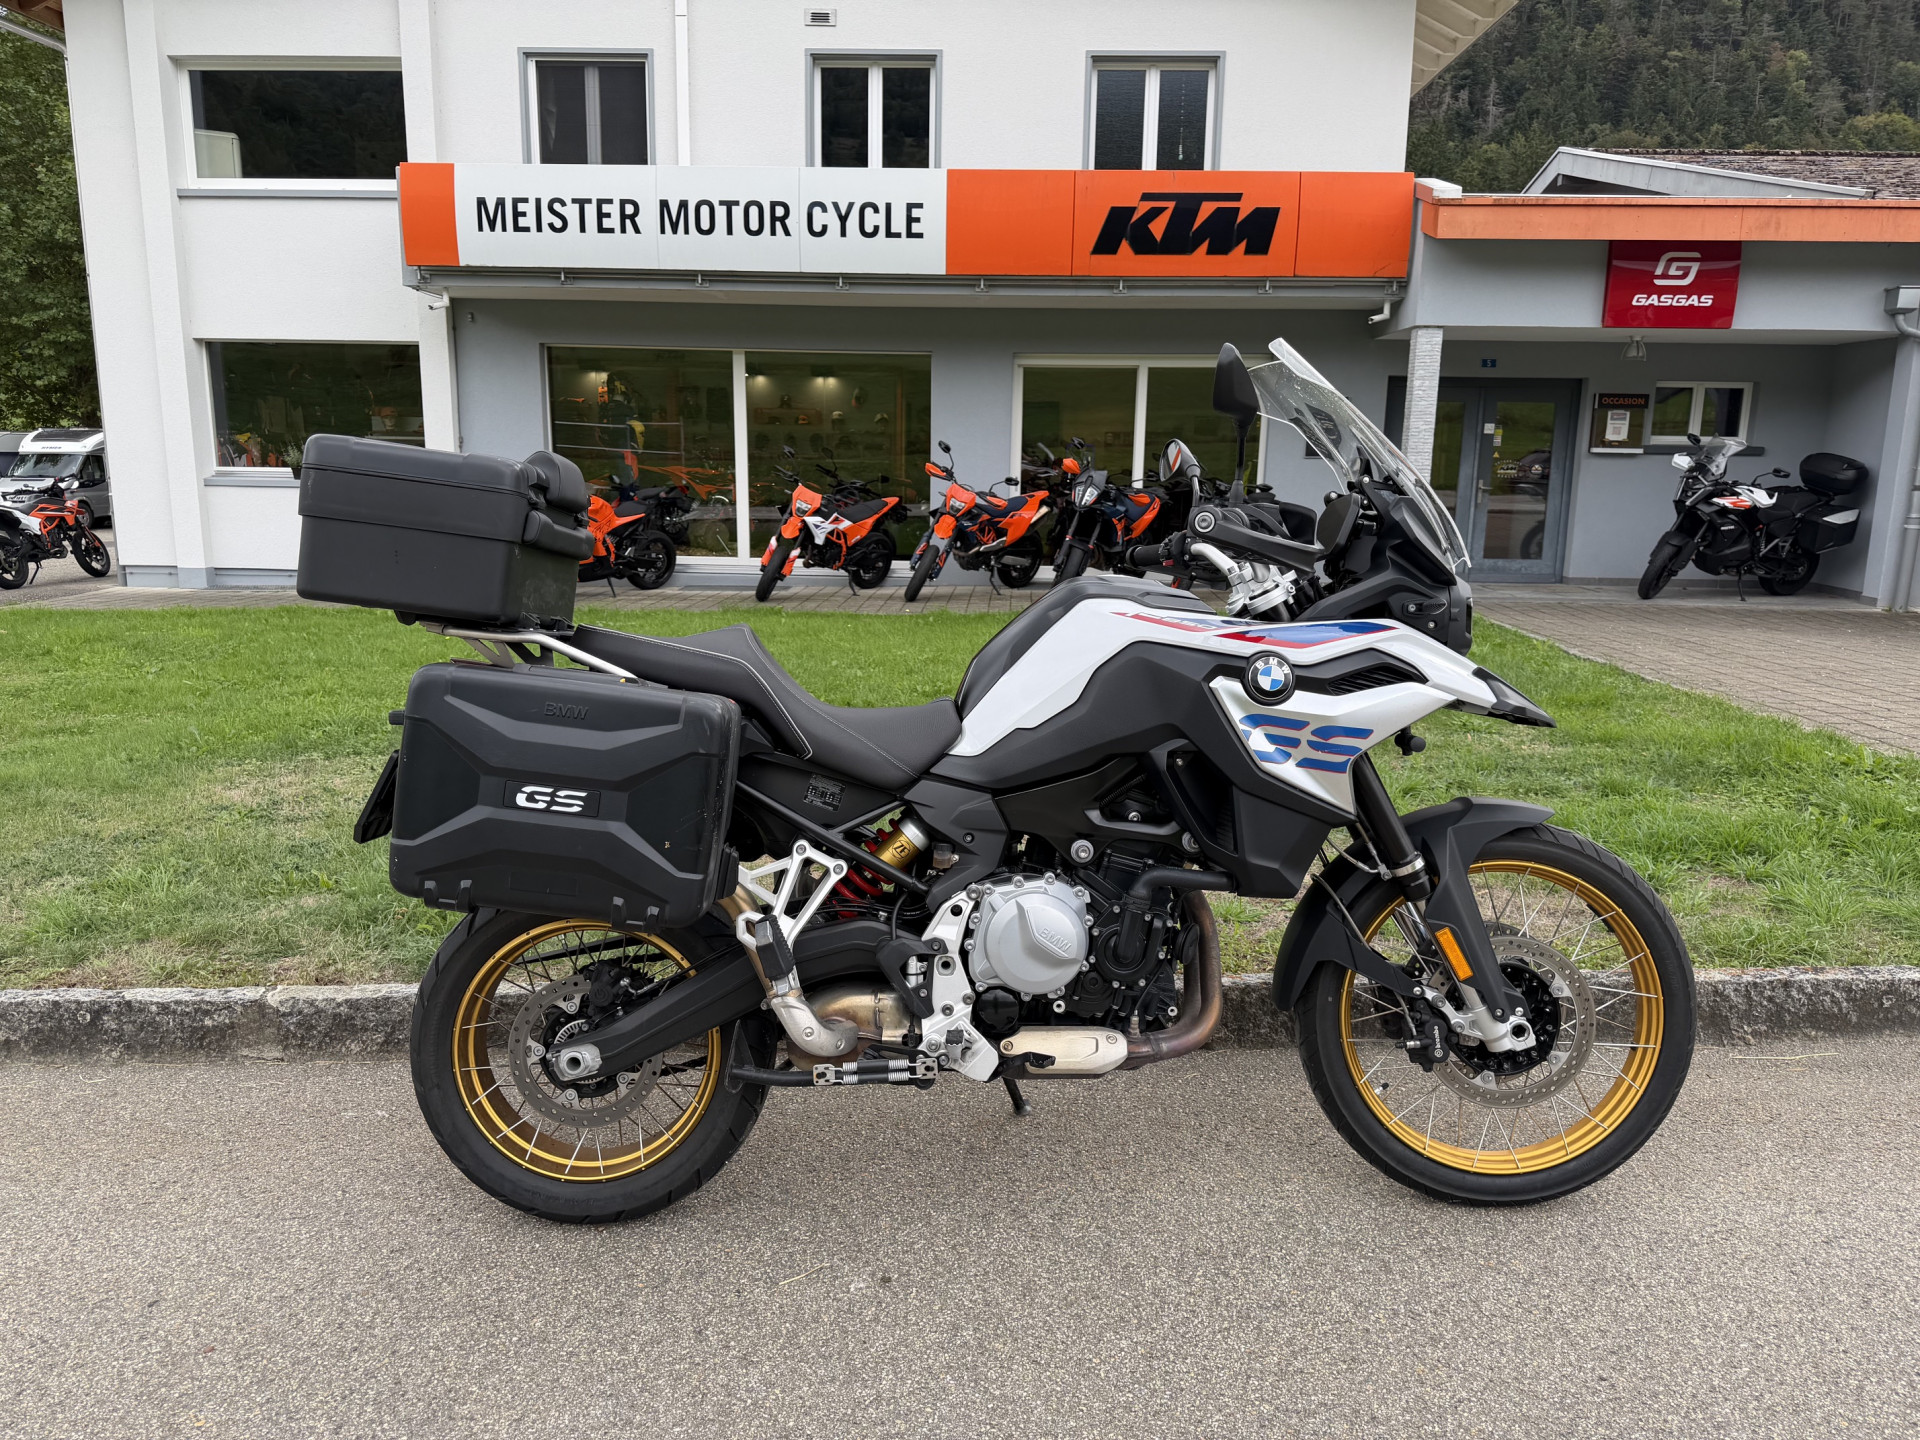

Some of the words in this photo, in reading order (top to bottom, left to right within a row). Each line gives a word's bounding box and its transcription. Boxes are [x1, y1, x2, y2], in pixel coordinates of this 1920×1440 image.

[475, 196, 642, 235] MEISTER
[658, 198, 793, 236] MOTOR
[805, 200, 925, 239] CYCLE
[1090, 192, 1281, 256] KTM
[1631, 294, 1714, 307] GASGAS
[1601, 397, 1646, 405] OCCASION
[1255, 656, 1291, 674] BMW
[543, 702, 589, 720] BMW
[515, 785, 588, 813] GS
[1039, 928, 1072, 952] BMW
[1433, 1025, 1441, 1049] brembo
